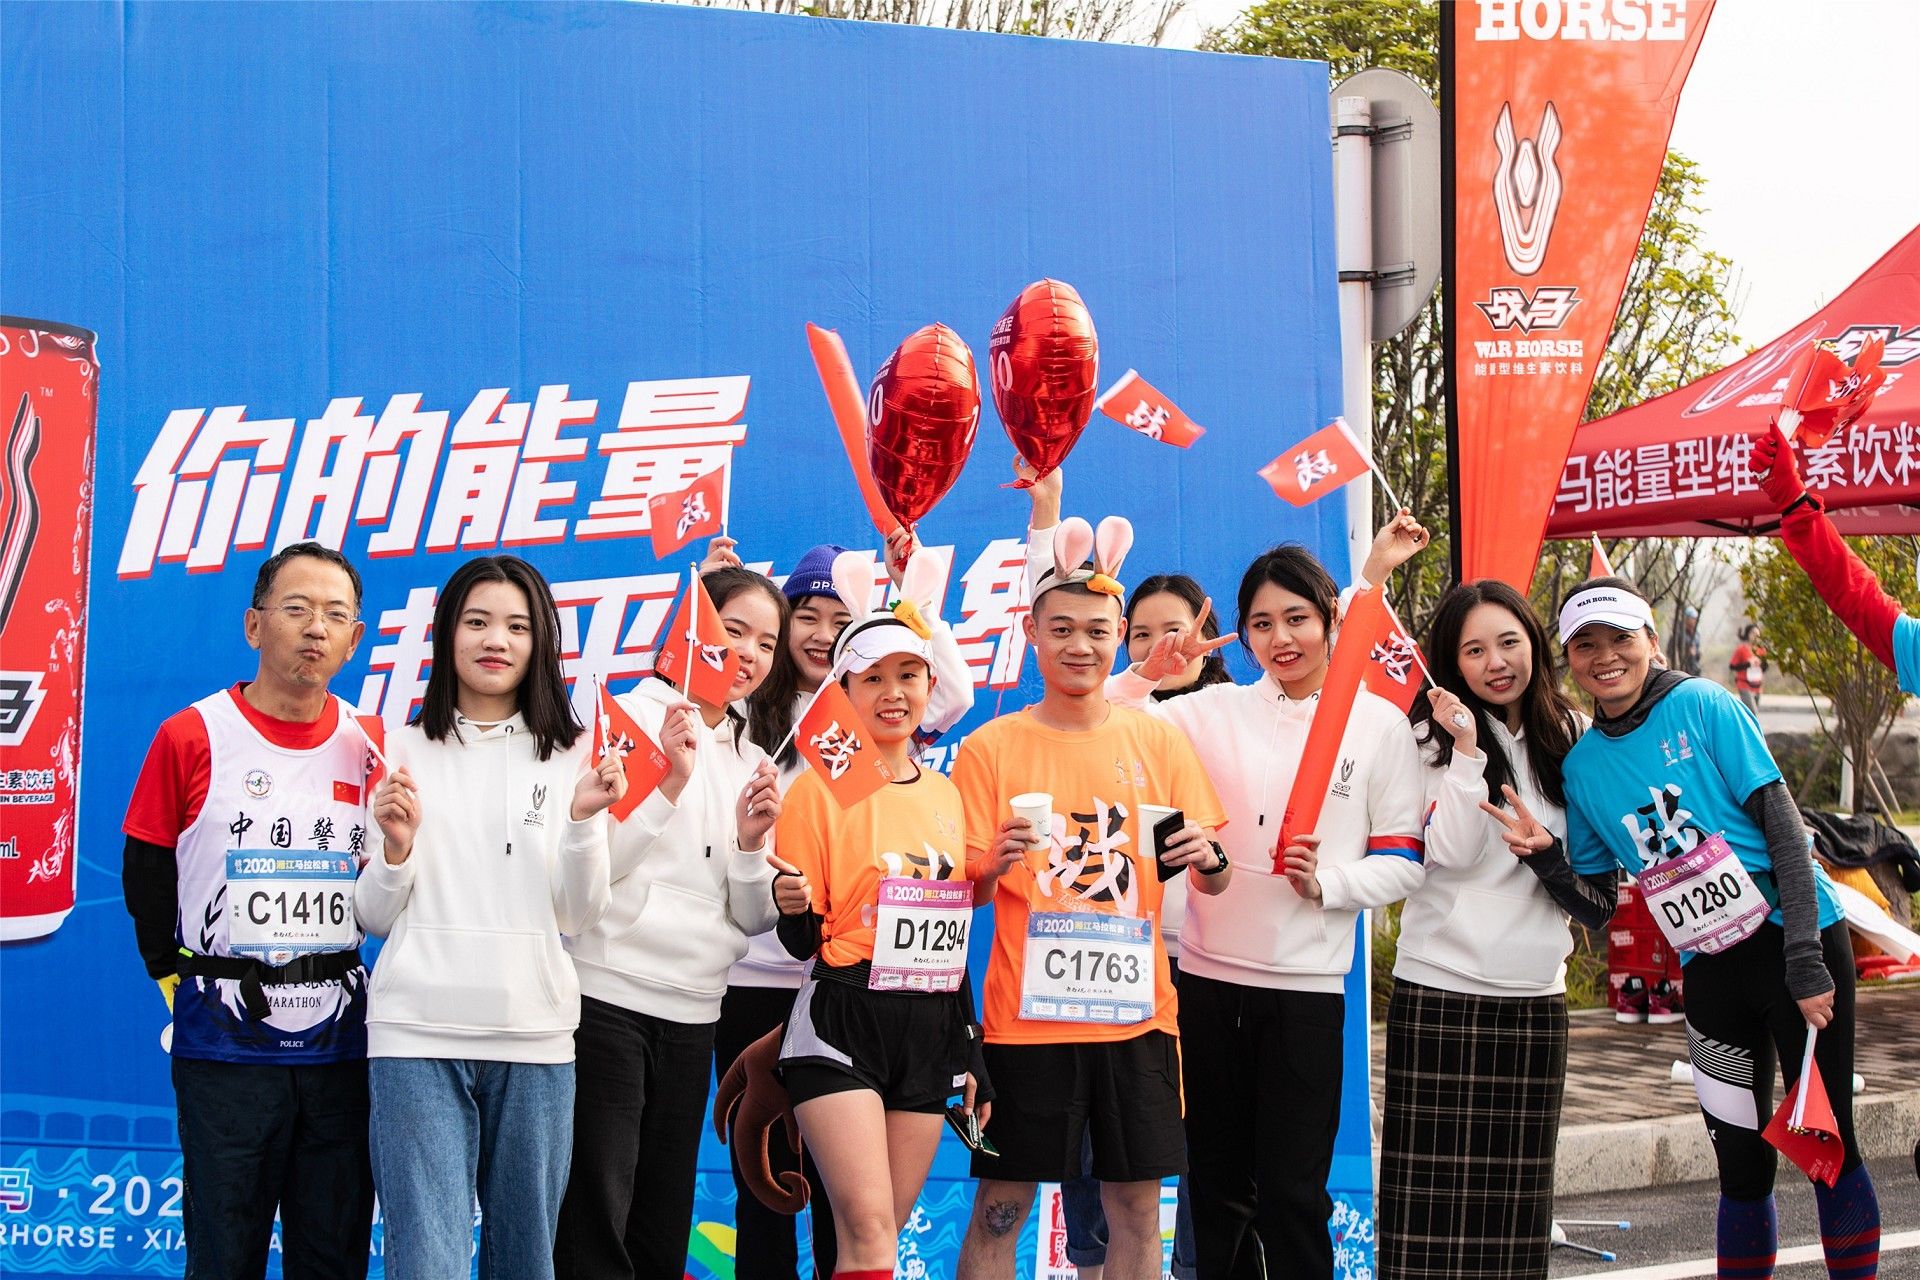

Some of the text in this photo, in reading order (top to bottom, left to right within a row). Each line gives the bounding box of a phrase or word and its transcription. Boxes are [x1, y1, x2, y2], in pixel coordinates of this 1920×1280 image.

[1475, 0, 1686, 41] HORSE
[1515, 340, 1583, 357] HORSE
[116, 374, 751, 581] 你的能量
[1577, 598, 1591, 607] WAR
[12, 795, 53, 803] BEVERAGE
[229, 811, 366, 857] 中国警察
[247, 891, 345, 925] C1416
[1661, 872, 1742, 929] D1280
[894, 918, 966, 951] D1294
[1044, 948, 1140, 984] C1763
[280, 1040, 305, 1048] POLICE
